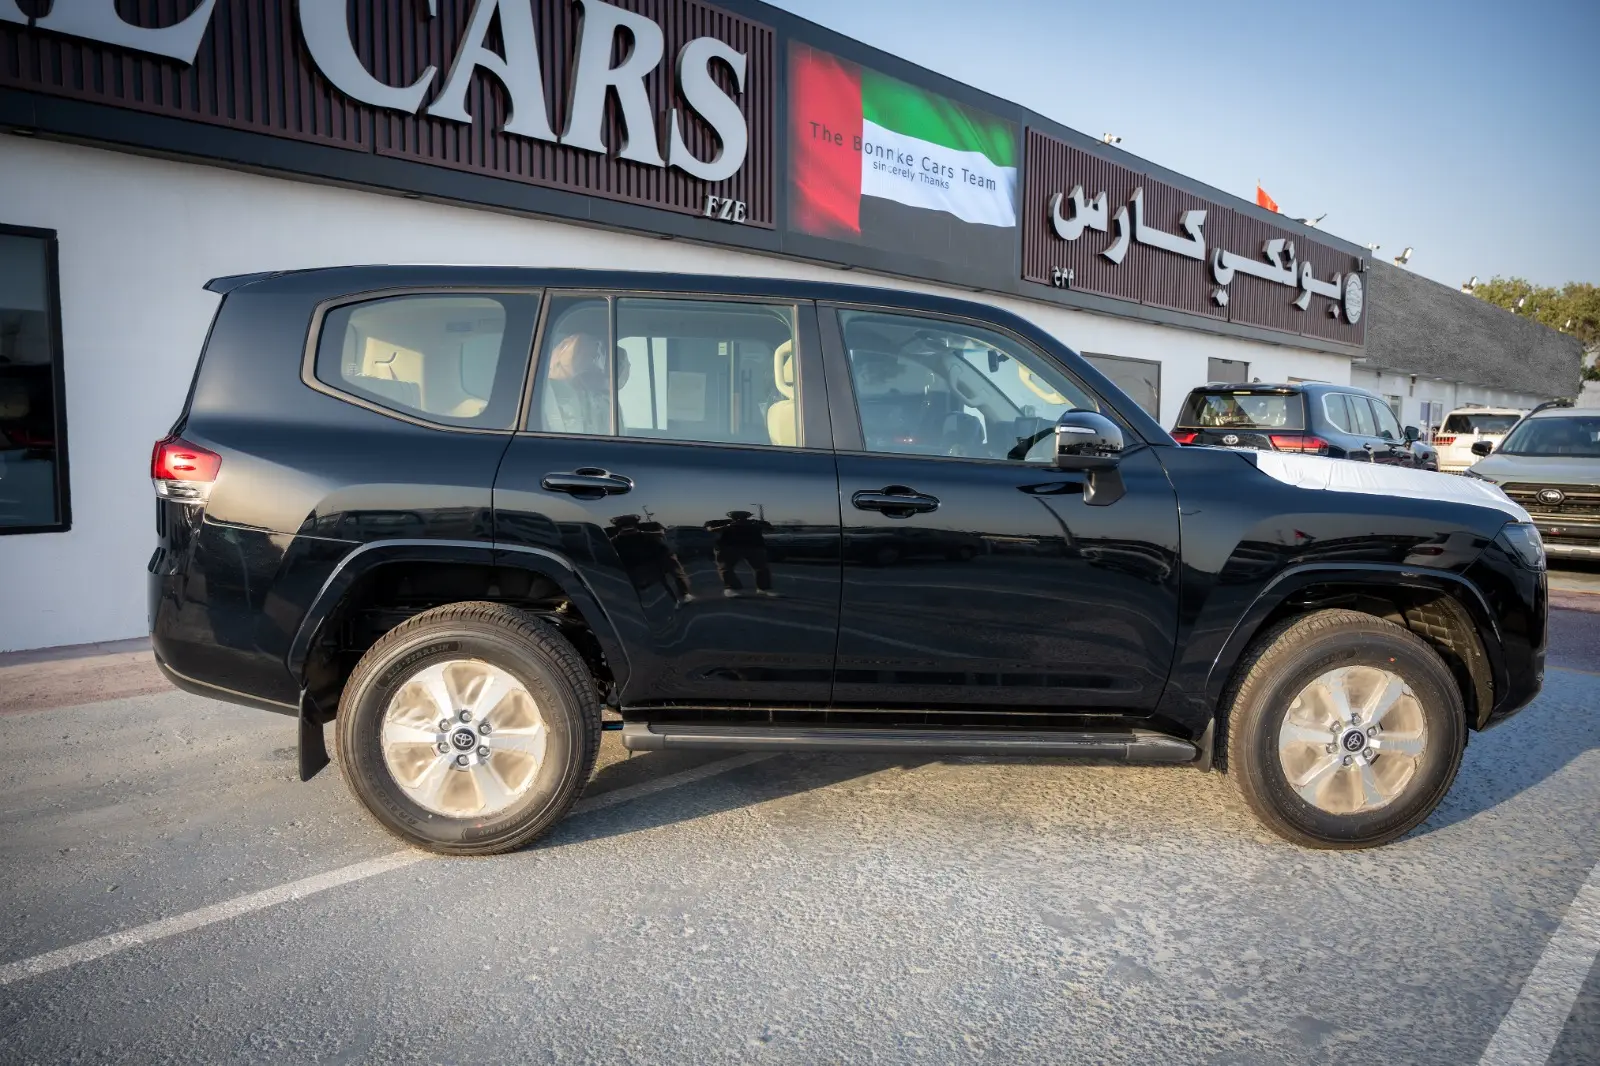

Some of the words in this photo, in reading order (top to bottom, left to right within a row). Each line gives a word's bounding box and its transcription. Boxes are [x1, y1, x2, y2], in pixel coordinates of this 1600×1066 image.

[298, 0, 748, 182] CARS
[809, 121, 844, 147] The
[853, 135, 914, 167] Bonnke
[921, 156, 955, 179] Cars
[961, 167, 997, 191] Team
[872, 160, 916, 182] sincerely
[918, 171, 950, 190] Thanks
[704, 194, 747, 224] FZE
[1048, 184, 1208, 265] كارس
